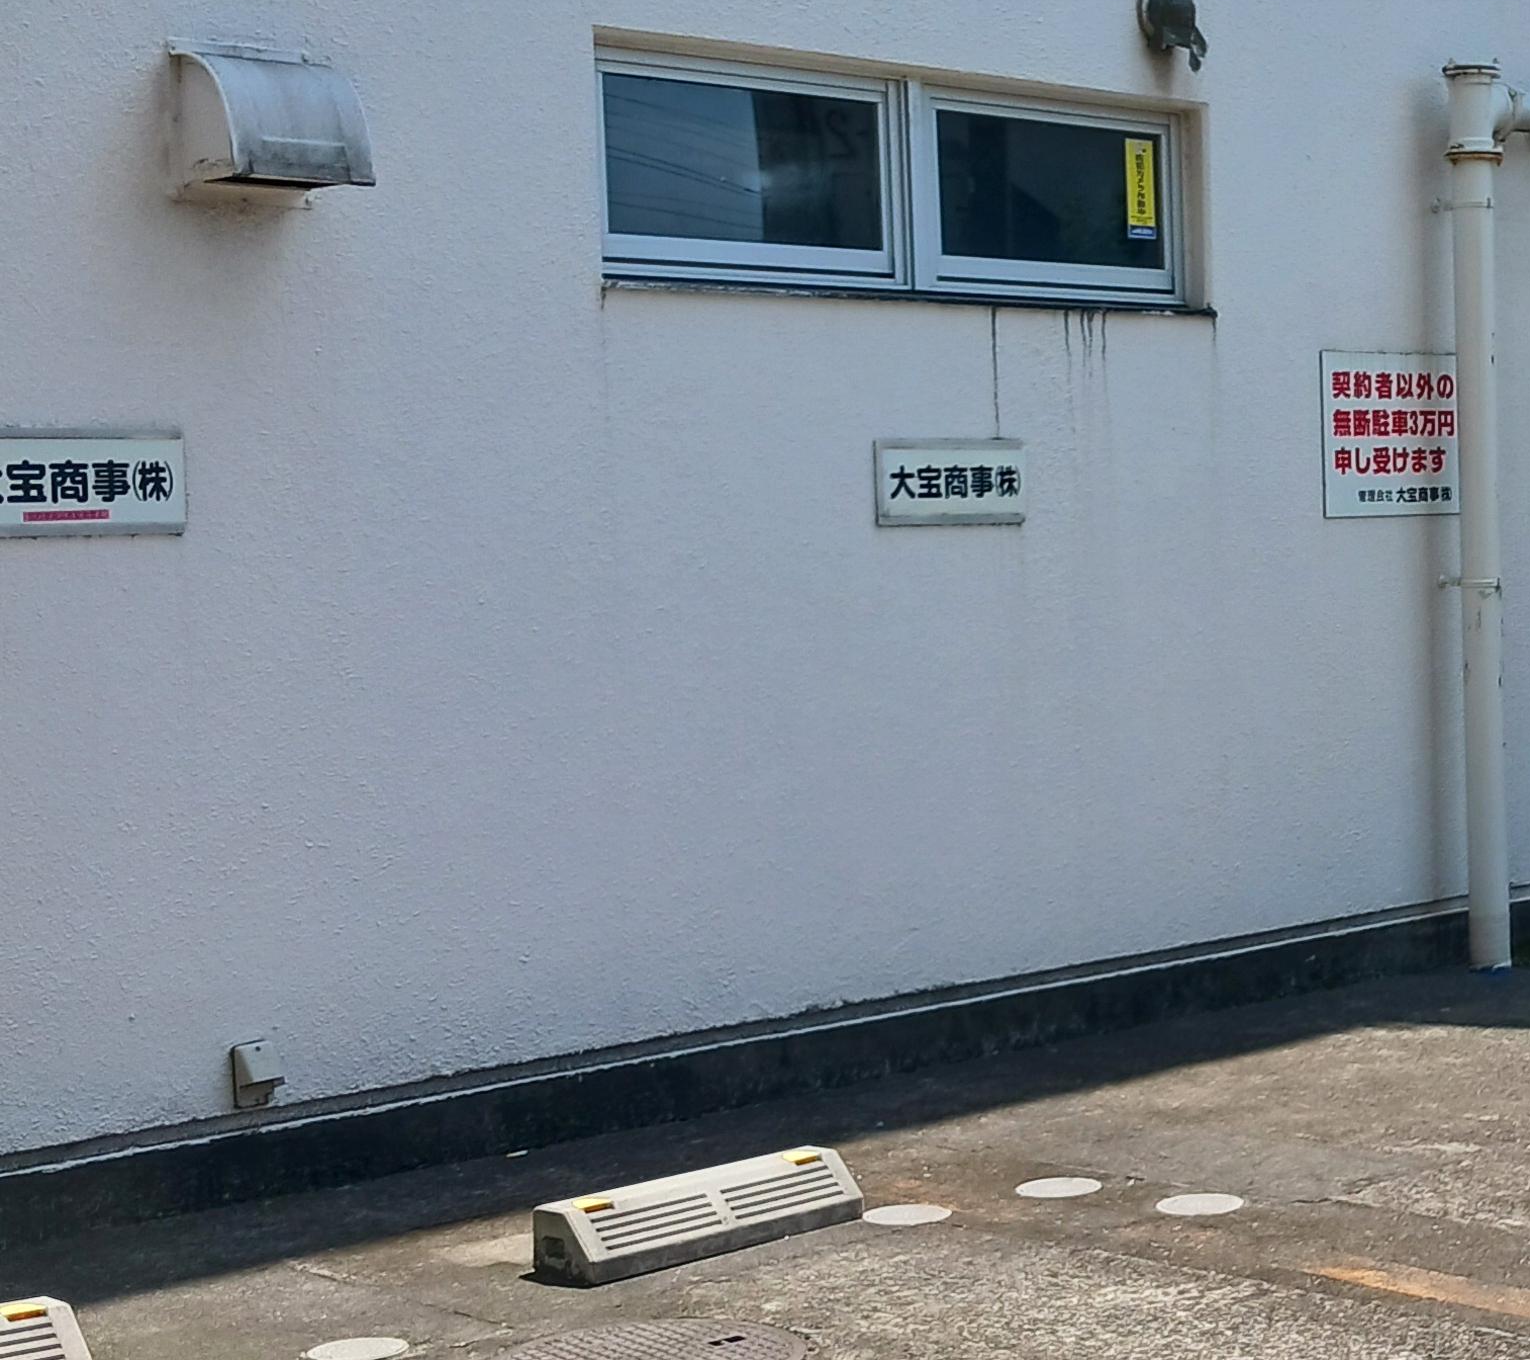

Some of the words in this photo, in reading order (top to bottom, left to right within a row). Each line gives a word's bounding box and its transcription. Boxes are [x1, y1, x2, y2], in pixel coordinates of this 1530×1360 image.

[1332, 371, 1454, 400] 契約者以外の
[1333, 409, 1455, 437] 無断駐車3万円
[1334, 446, 1446, 475] 申し受けます
[0, 459, 173, 503] 宝商事(株)
